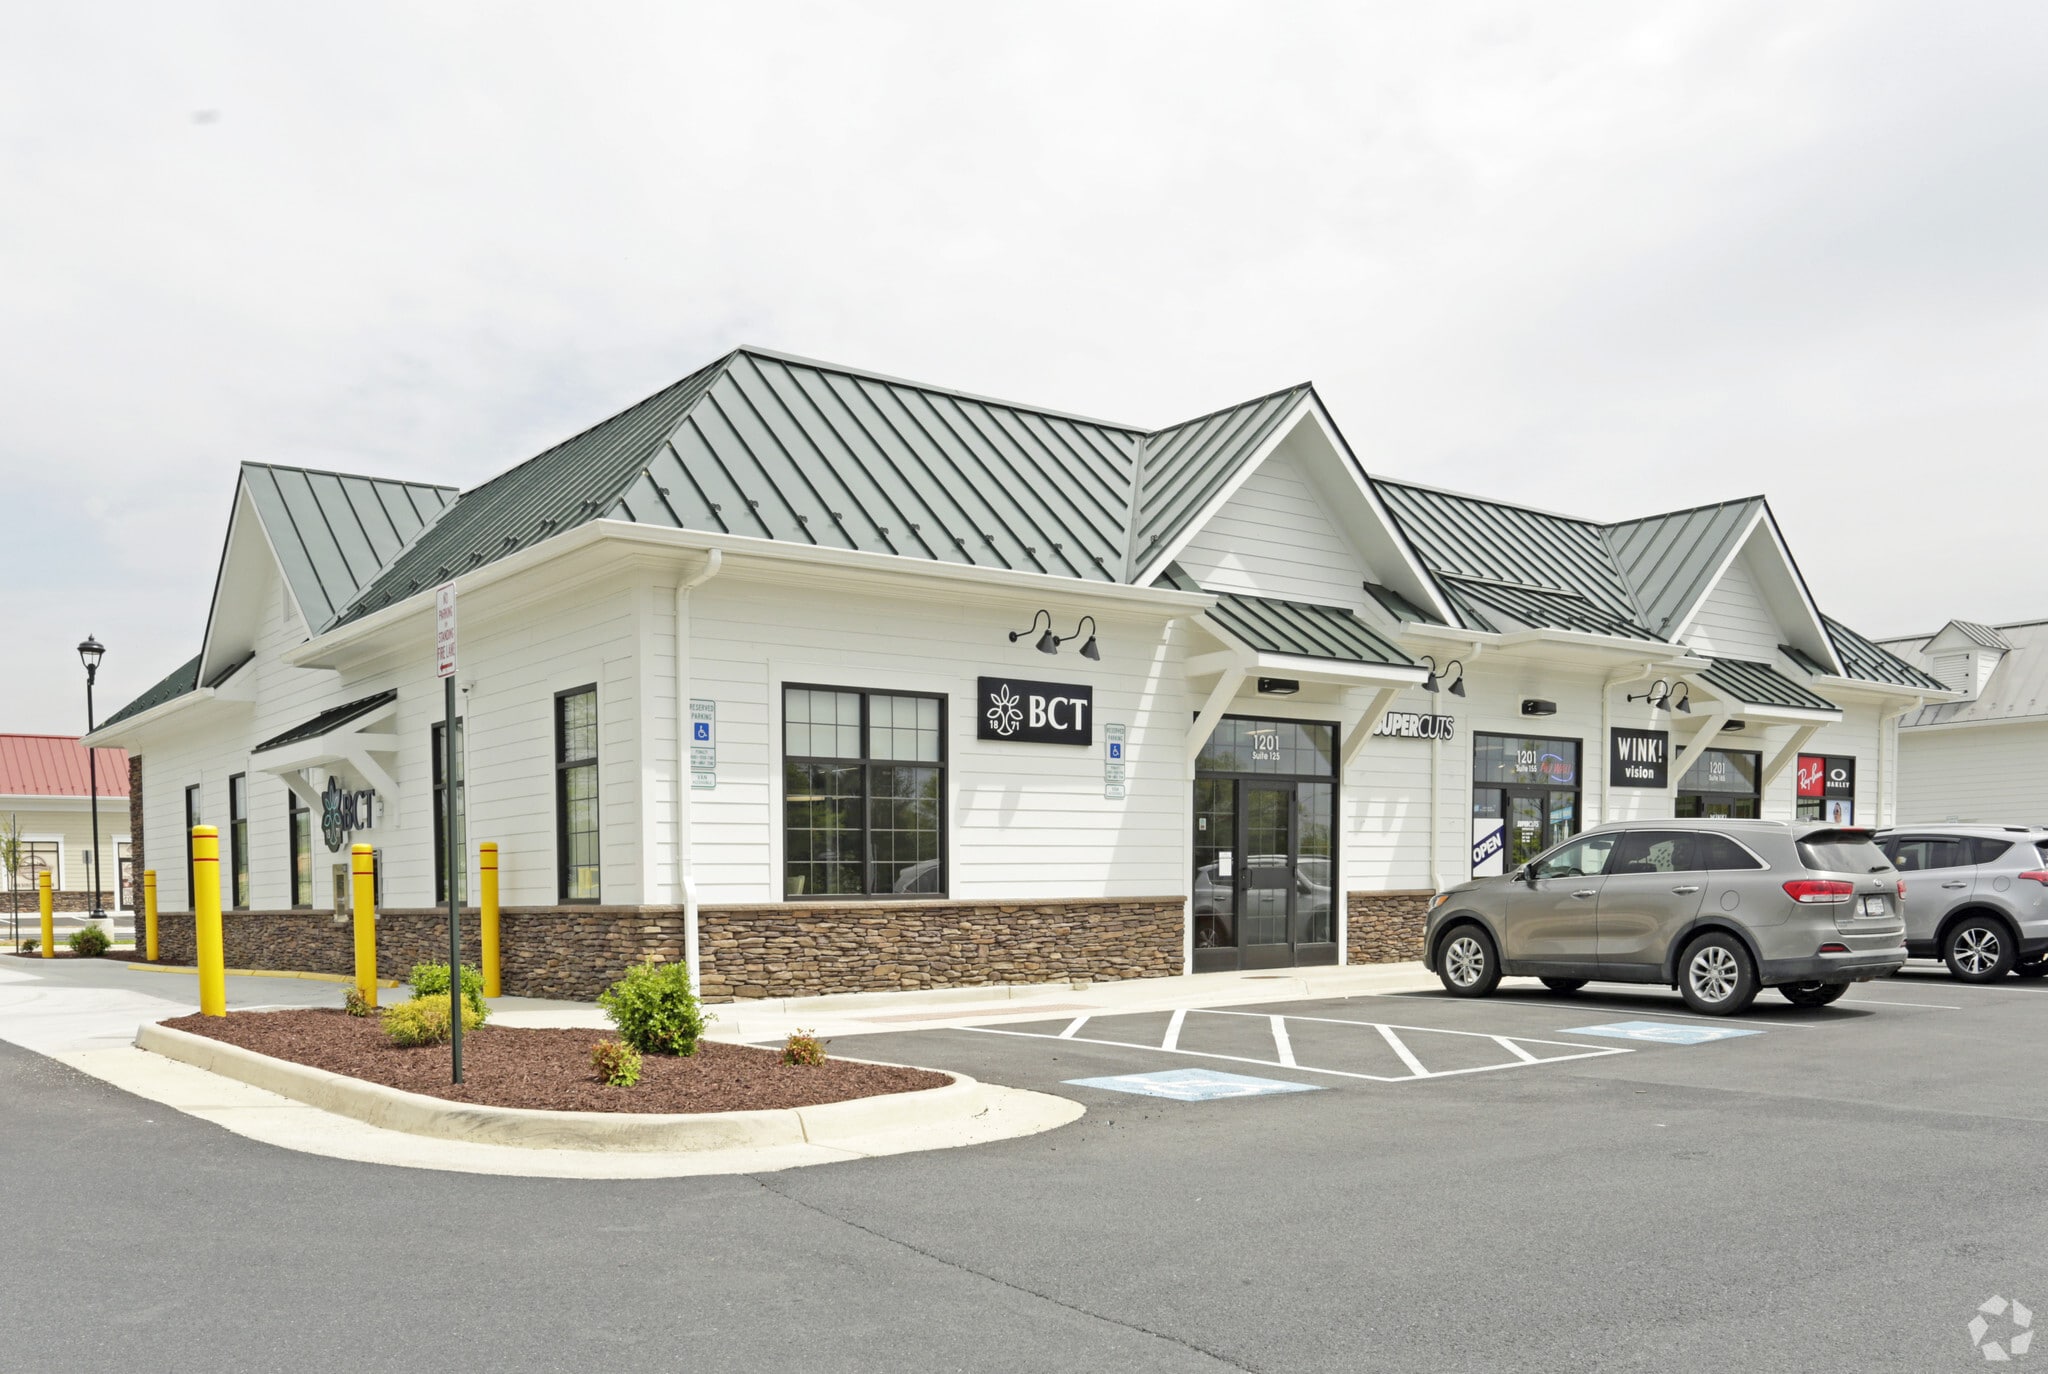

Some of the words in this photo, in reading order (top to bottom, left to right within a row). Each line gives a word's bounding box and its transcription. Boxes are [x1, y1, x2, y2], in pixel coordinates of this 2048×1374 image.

[689, 703, 715, 713] RESERVED
[1028, 695, 1088, 731] BCT
[691, 712, 713, 721] PARKING
[989, 719, 999, 730] 18
[1010, 721, 1020, 731] 71
[1253, 734, 1279, 751] 1201
[1617, 736, 1663, 764] WINK!
[1251, 750, 1269, 760] Suite
[1269, 751, 1281, 761] 125
[1516, 750, 1538, 765] 1201
[1625, 765, 1655, 780] vision
[1709, 761, 1726, 775] 1201
[1826, 781, 1851, 789] OAKLEY
[342, 788, 376, 832] BCT
[1472, 833, 1502, 863] OPEN
